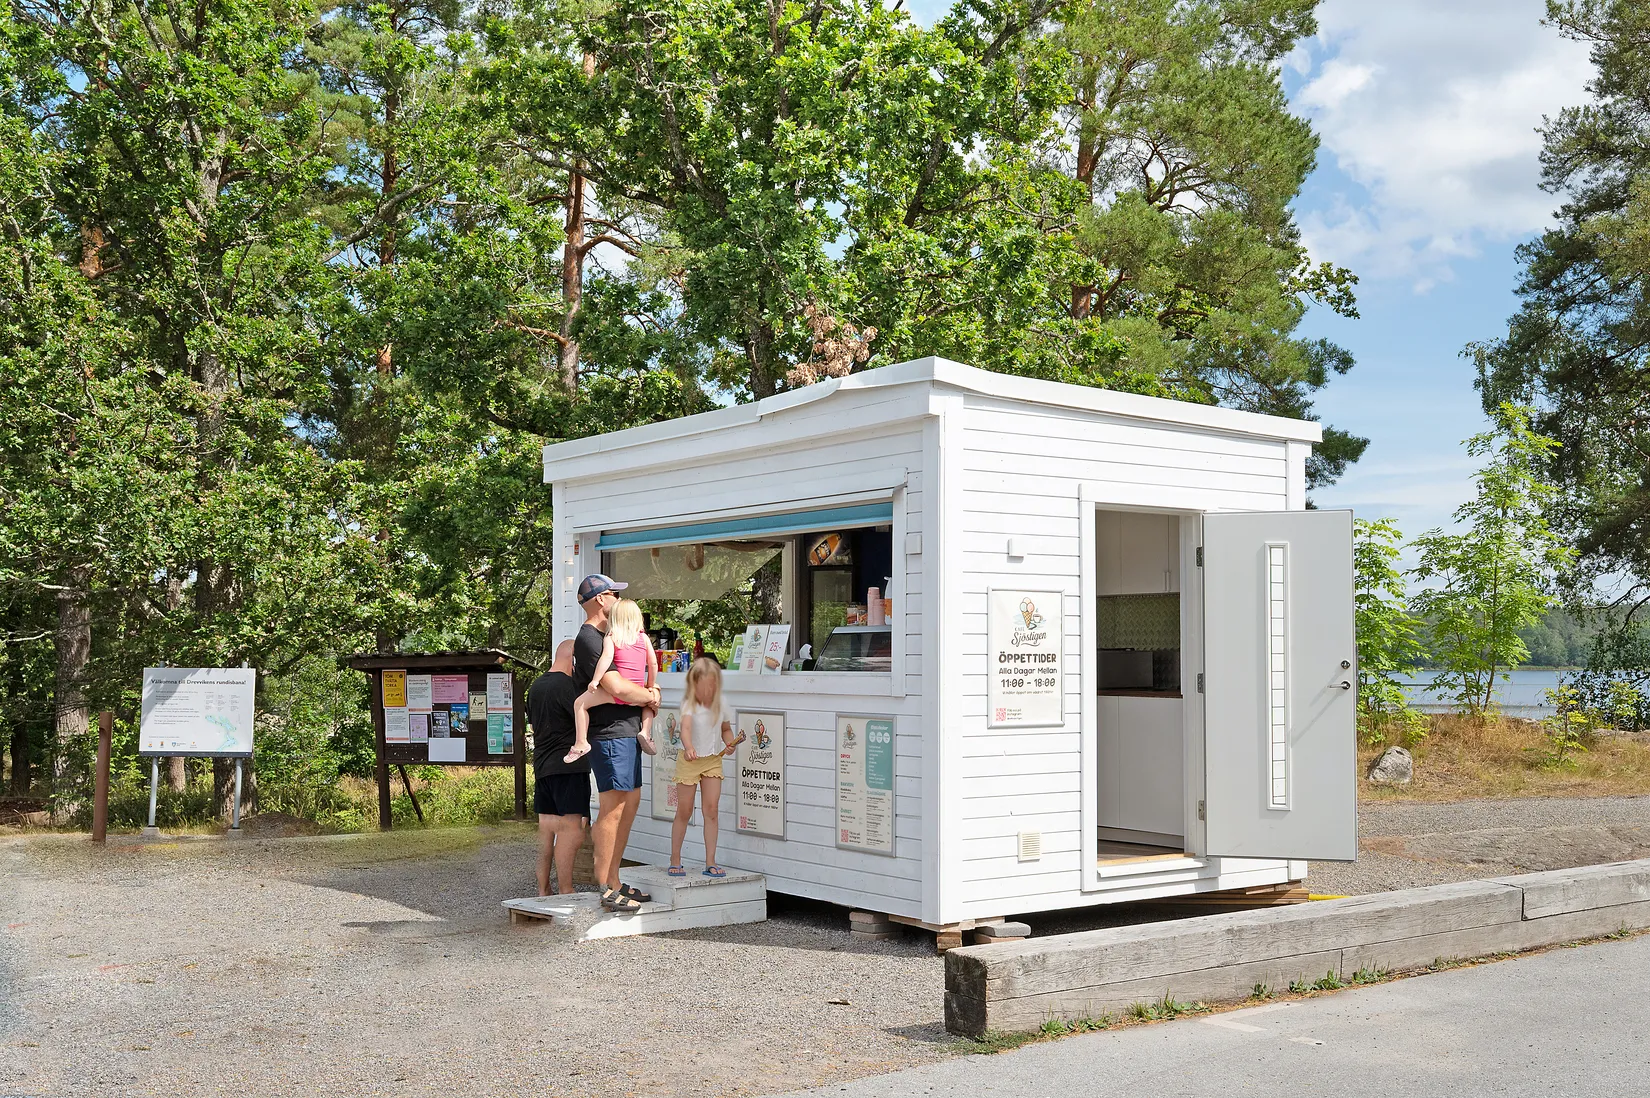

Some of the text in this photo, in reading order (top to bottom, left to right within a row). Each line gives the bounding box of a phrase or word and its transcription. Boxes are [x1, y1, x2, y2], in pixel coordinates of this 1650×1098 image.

[1011, 632, 1046, 647] Sjöstigen
[770, 642, 782, 652] 25:-
[998, 651, 1056, 664] ÖPPETTIDER
[1014, 668, 1036, 676] Dagar
[1000, 678, 1024, 688] 11:00
[1034, 678, 1056, 688] 18:00
[742, 767, 780, 781] ÖPPETTIDER
[750, 782, 765, 791] Dagar
[743, 792, 757, 800] 11:00
[764, 794, 779, 803] 18:00
